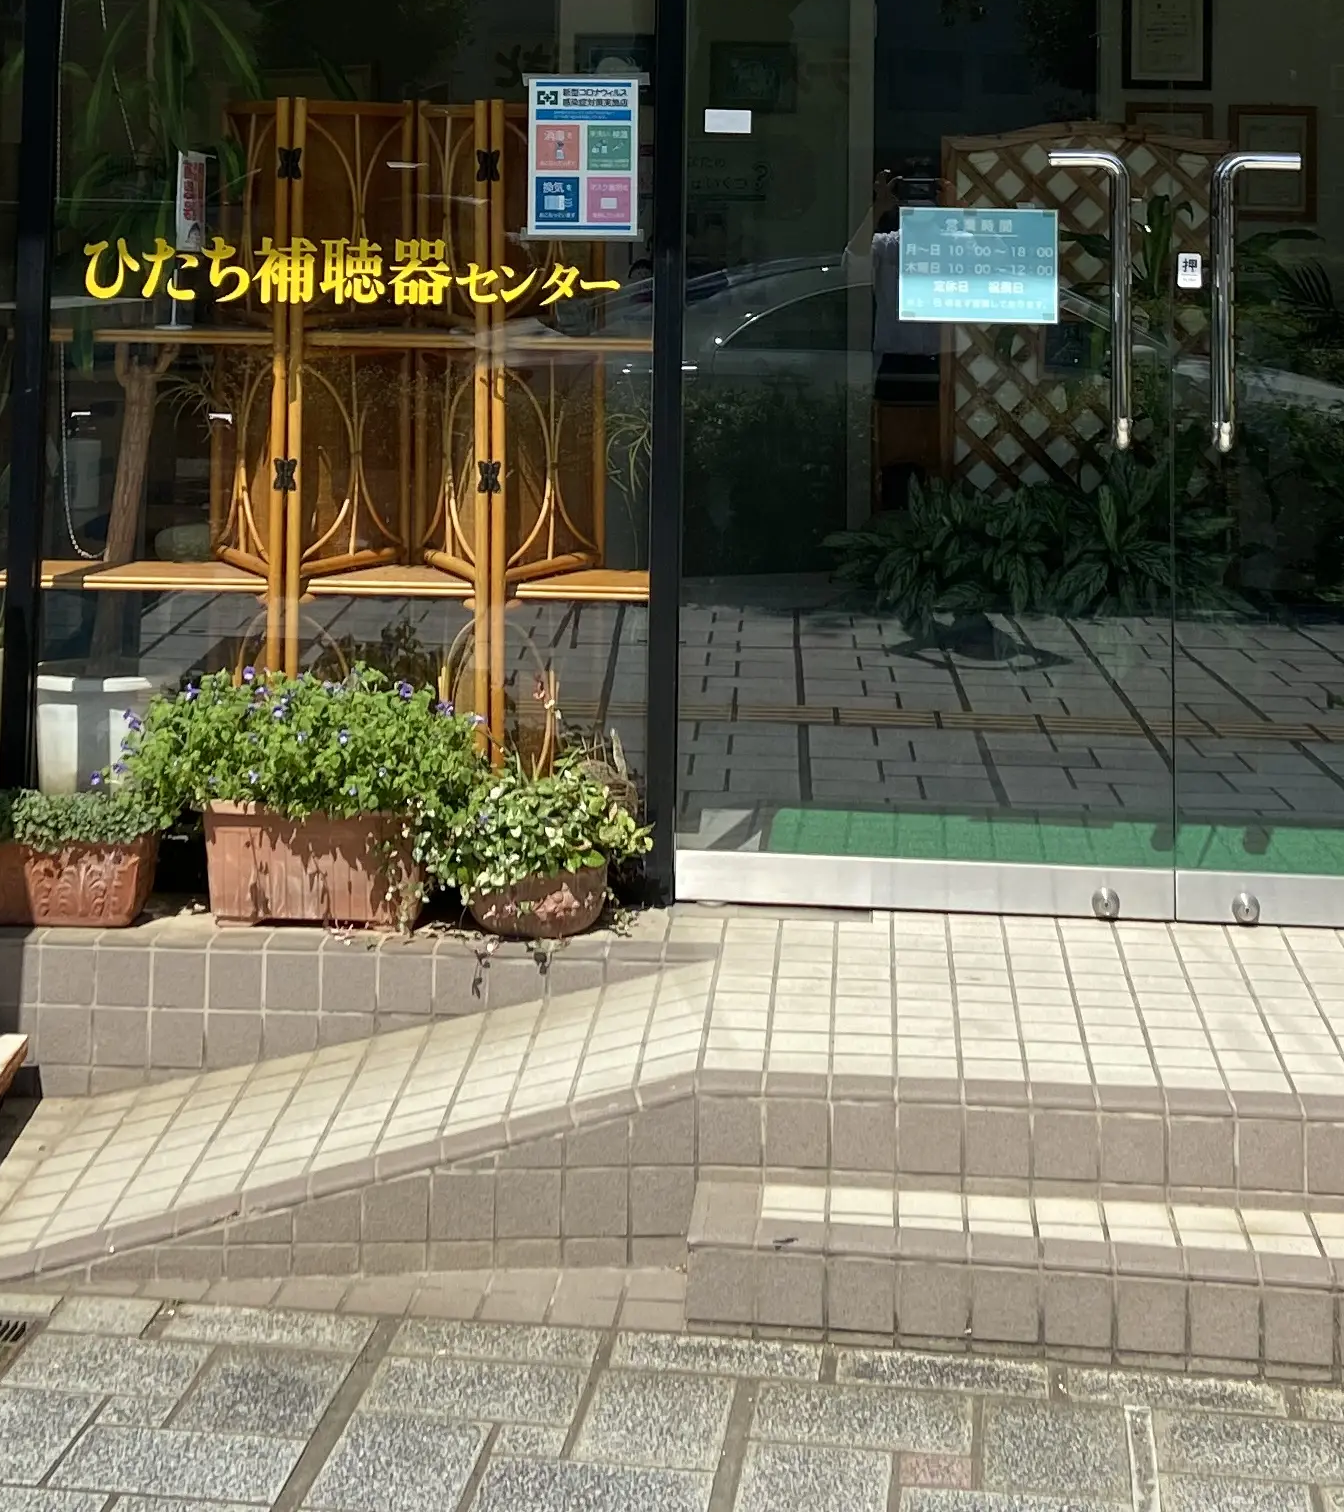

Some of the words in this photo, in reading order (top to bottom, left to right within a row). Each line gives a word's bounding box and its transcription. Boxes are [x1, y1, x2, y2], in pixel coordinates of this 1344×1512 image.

[82, 236, 622, 307] ひたち補聴器センター
[1182, 257, 1198, 273] 押
